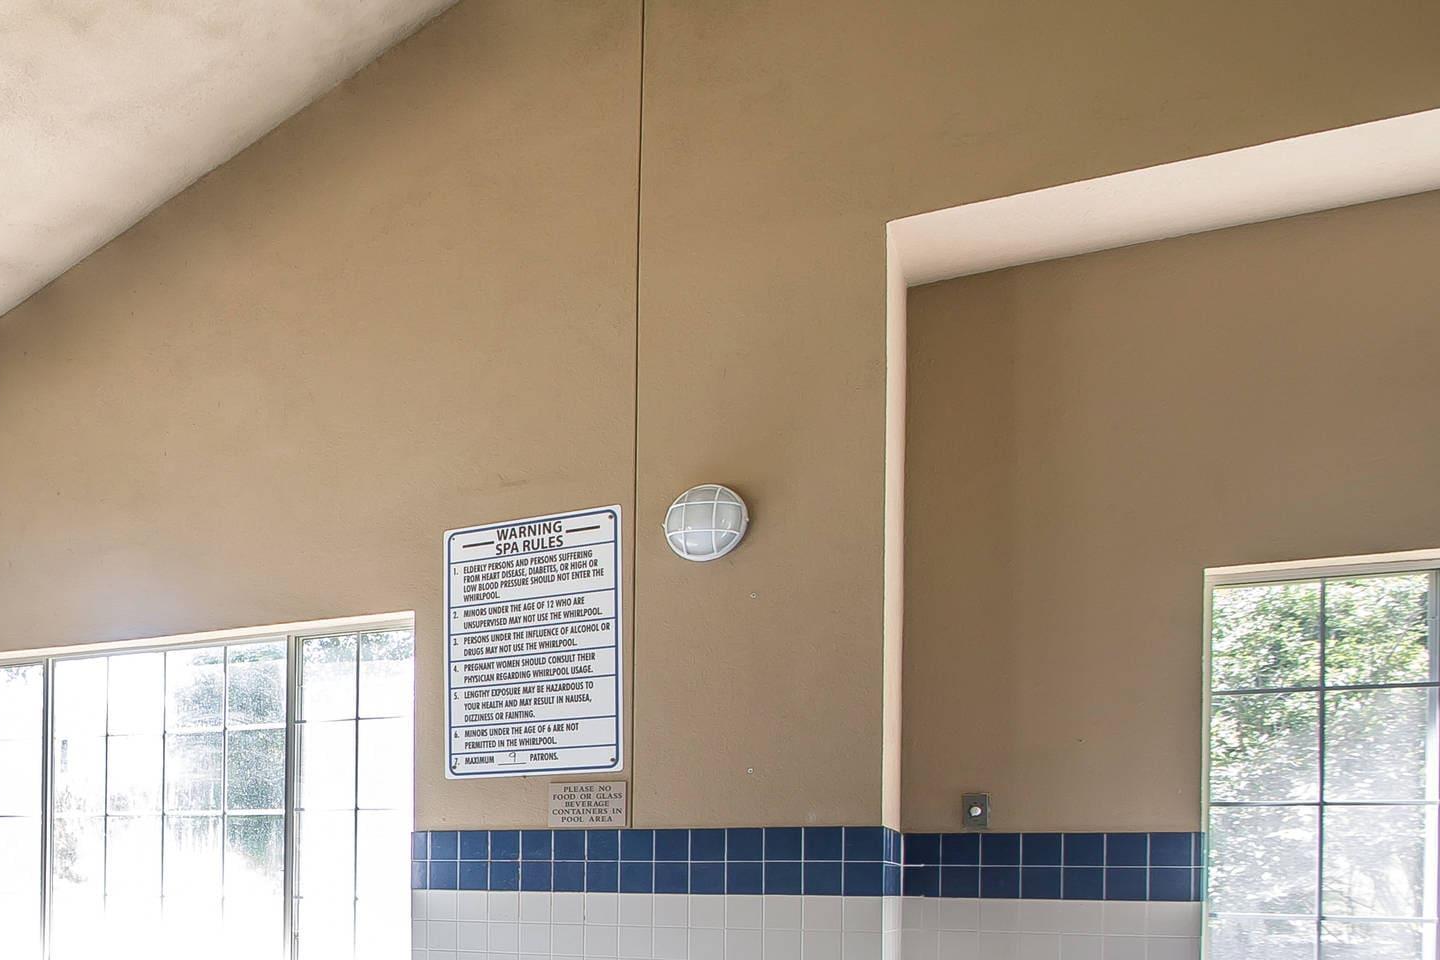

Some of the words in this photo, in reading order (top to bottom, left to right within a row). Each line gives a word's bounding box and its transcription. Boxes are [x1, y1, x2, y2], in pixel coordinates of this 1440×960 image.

[497, 521, 562, 540] WARNING
[496, 543, 519, 555] SPA
[523, 536, 563, 551] RULES
[464, 564, 487, 574] ELDERLY
[488, 561, 514, 570] PERSONS
[516, 558, 528, 567] AND
[530, 555, 557, 565] PERSONS
[559, 550, 592, 561] SUFFERING
[464, 574, 480, 583] FROM
[482, 571, 500, 580] HEART
[560, 562, 569, 571] OR
[571, 561, 586, 569] HIGH
[589, 559, 597, 567] OR
[464, 584, 477, 592] LOW
[479, 581, 499, 591] BLOOD
[500, 578, 529, 588] PRESSURE
[531, 574, 555, 584] SHOULD
[557, 572, 570, 581] NOT
[572, 570, 590, 579] ENTER
[592, 568, 604, 576] THE
[464, 609, 487, 617] MINORS
[489, 606, 508, 615] UNDER
[510, 604, 521, 612] THE
[523, 602, 535, 611] AGE
[556, 599, 572, 607] WHO
[573, 597, 584, 605] ARE
[464, 618, 507, 629] UNSUPERVISED
[509, 616, 521, 624] MAY
[523, 615, 535, 623] NOT
[537, 613, 548, 621] USE
[550, 611, 561, 619] THE
[464, 635, 489, 644] PERSONS
[491, 633, 511, 642] UNDER
[526, 627, 558, 638] INFLUENCE
[560, 627, 568, 635] OF
[570, 624, 599, 634] ALCOHOL
[464, 648, 484, 656] DRUGS
[485, 646, 497, 654] MAY
[499, 644, 511, 652] NOT
[513, 643, 524, 651] USE
[526, 642, 537, 650] THE
[464, 662, 494, 671] PREGNANT
[496, 660, 520, 669] WOMEN
[522, 657, 546, 666] SHOULD
[548, 655, 575, 664] CONSULT
[577, 653, 595, 661] THEIR
[464, 673, 494, 683] PHYSICIAN
[496, 670, 530, 680] REGARDING
[533, 667, 569, 677] WHIRLPOOL
[464, 690, 490, 698] LENGTHY
[491, 687, 520, 697] EXPOSURE
[522, 685, 535, 694] MAY
[537, 685, 544, 693] BE
[546, 682, 583, 692] HAZARDOUS
[585, 681, 593, 689] TO
[464, 702, 480, 710] YOUR
[482, 700, 503, 709] HEALTH
[505, 699, 517, 707] AND
[519, 697, 532, 706] MAY
[534, 696, 555, 705] RESULT
[464, 713, 493, 722] DIZZINESS
[495, 712, 504, 720] OR
[464, 728, 487, 737] MINORS
[489, 727, 509, 736] UNDER
[512, 726, 522, 734] THE
[524, 725, 536, 734] AGE
[553, 723, 564, 731] ARE
[566, 723, 578, 731] NOT
[464, 740, 496, 750] PERMITTED
[498, 739, 505, 747] IN
[506, 738, 517, 747] THE
[464, 755, 494, 764] MAXIMUM
[509, 752, 516, 762] 9
